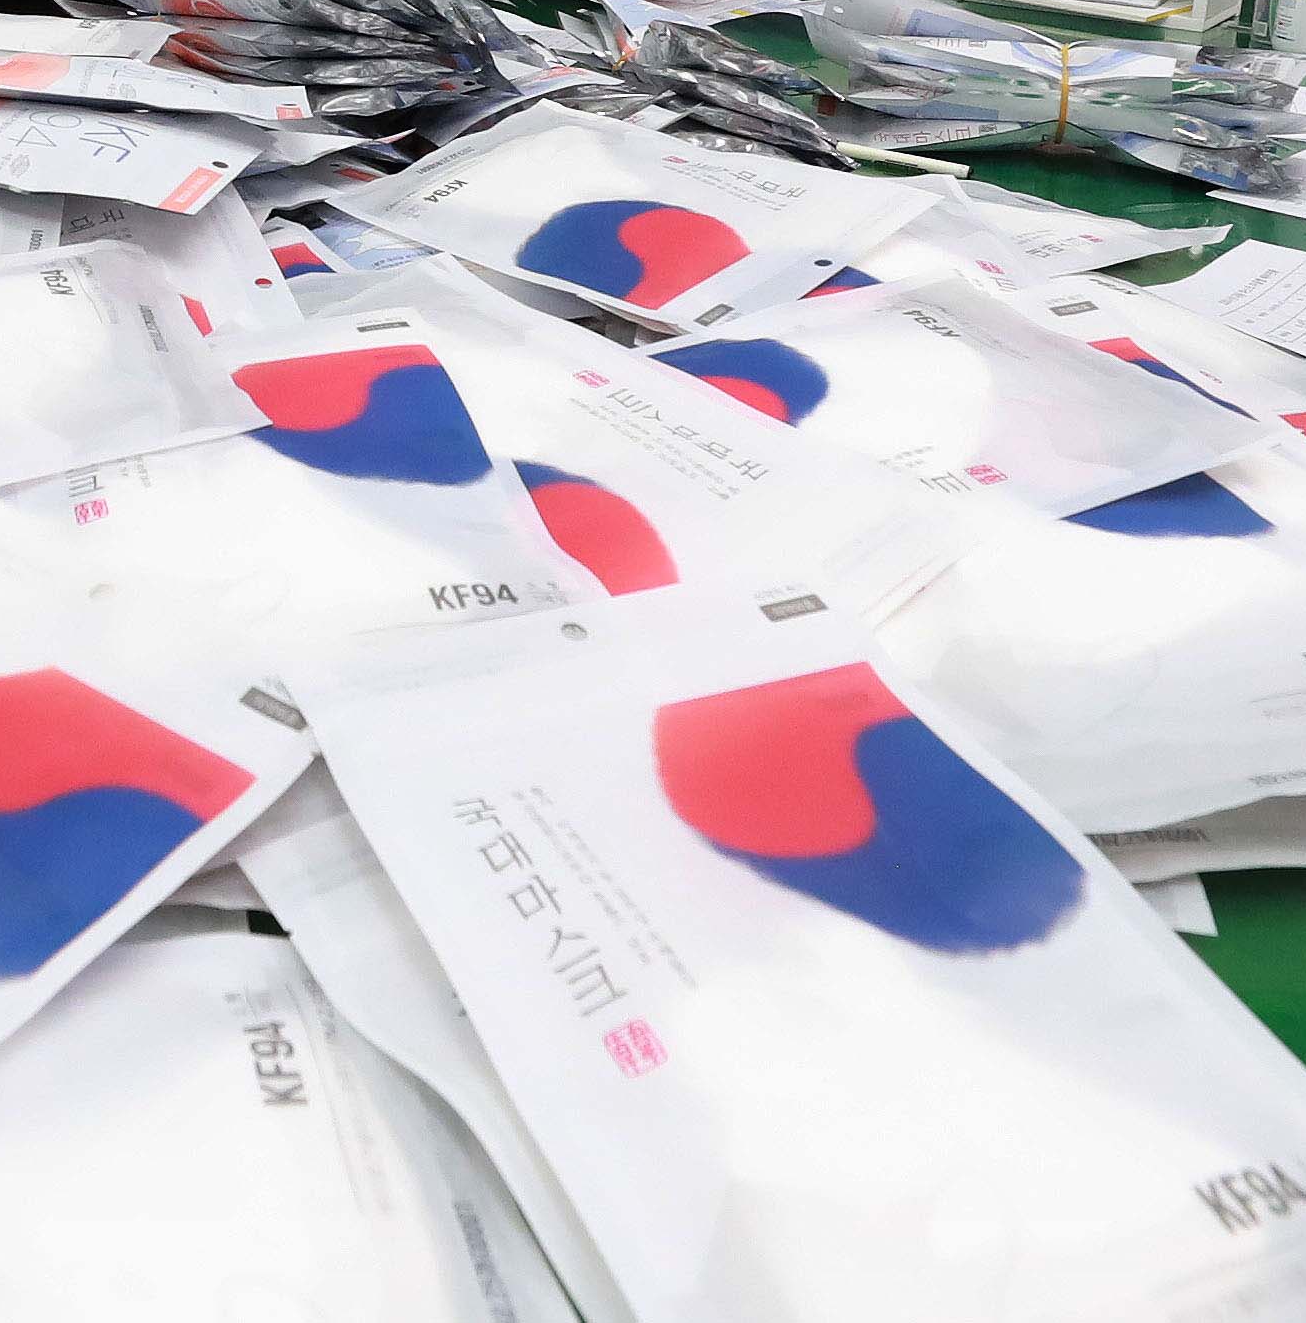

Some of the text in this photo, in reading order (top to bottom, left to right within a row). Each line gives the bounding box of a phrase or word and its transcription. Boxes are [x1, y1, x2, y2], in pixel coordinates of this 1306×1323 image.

[38, 267, 76, 297] KF94
[428, 581, 520, 611] KF94
[243, 1022, 310, 1109] KF94
